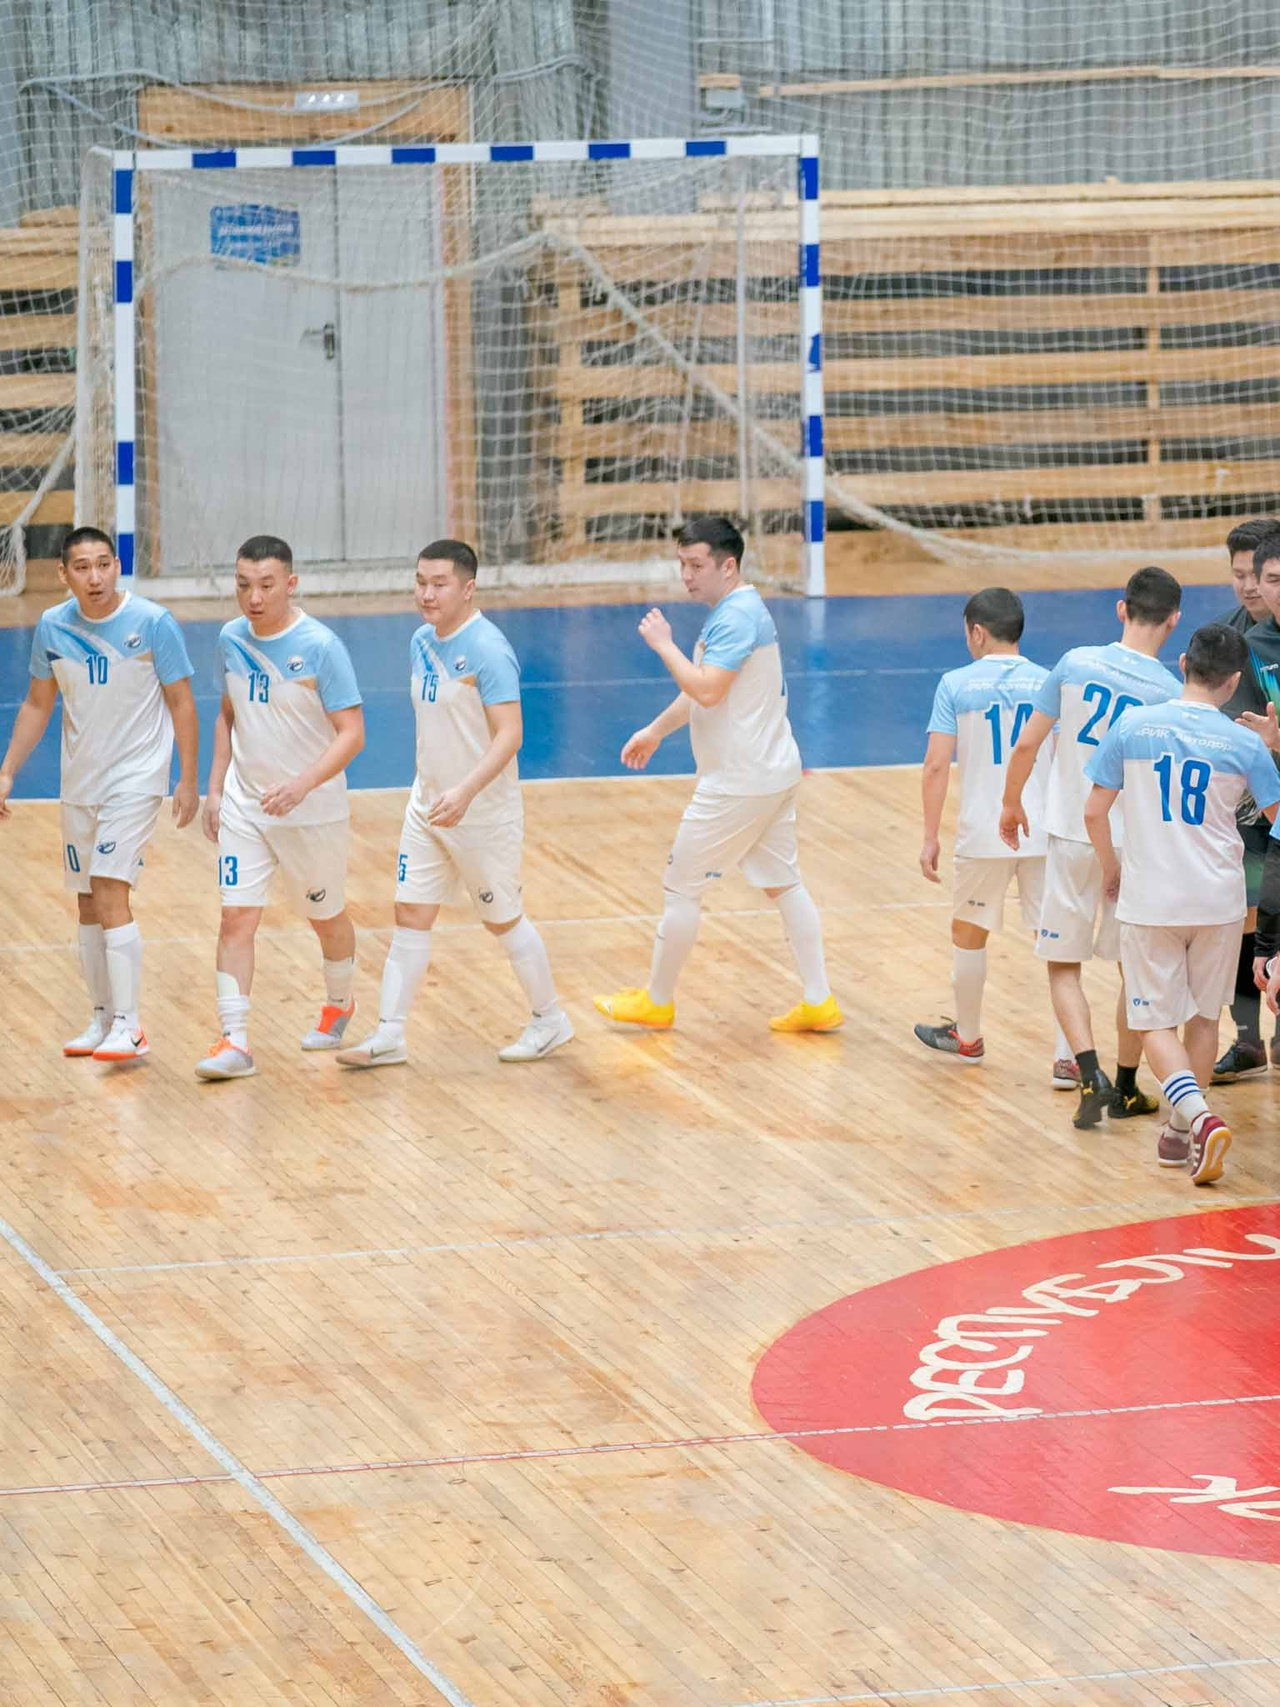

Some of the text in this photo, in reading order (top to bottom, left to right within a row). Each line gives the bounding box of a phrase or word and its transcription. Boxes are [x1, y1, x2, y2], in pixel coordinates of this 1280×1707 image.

[86, 655, 109, 685] 10
[248, 672, 270, 703] 13
[421, 673, 440, 703] 15
[1153, 754, 1212, 826] 18
